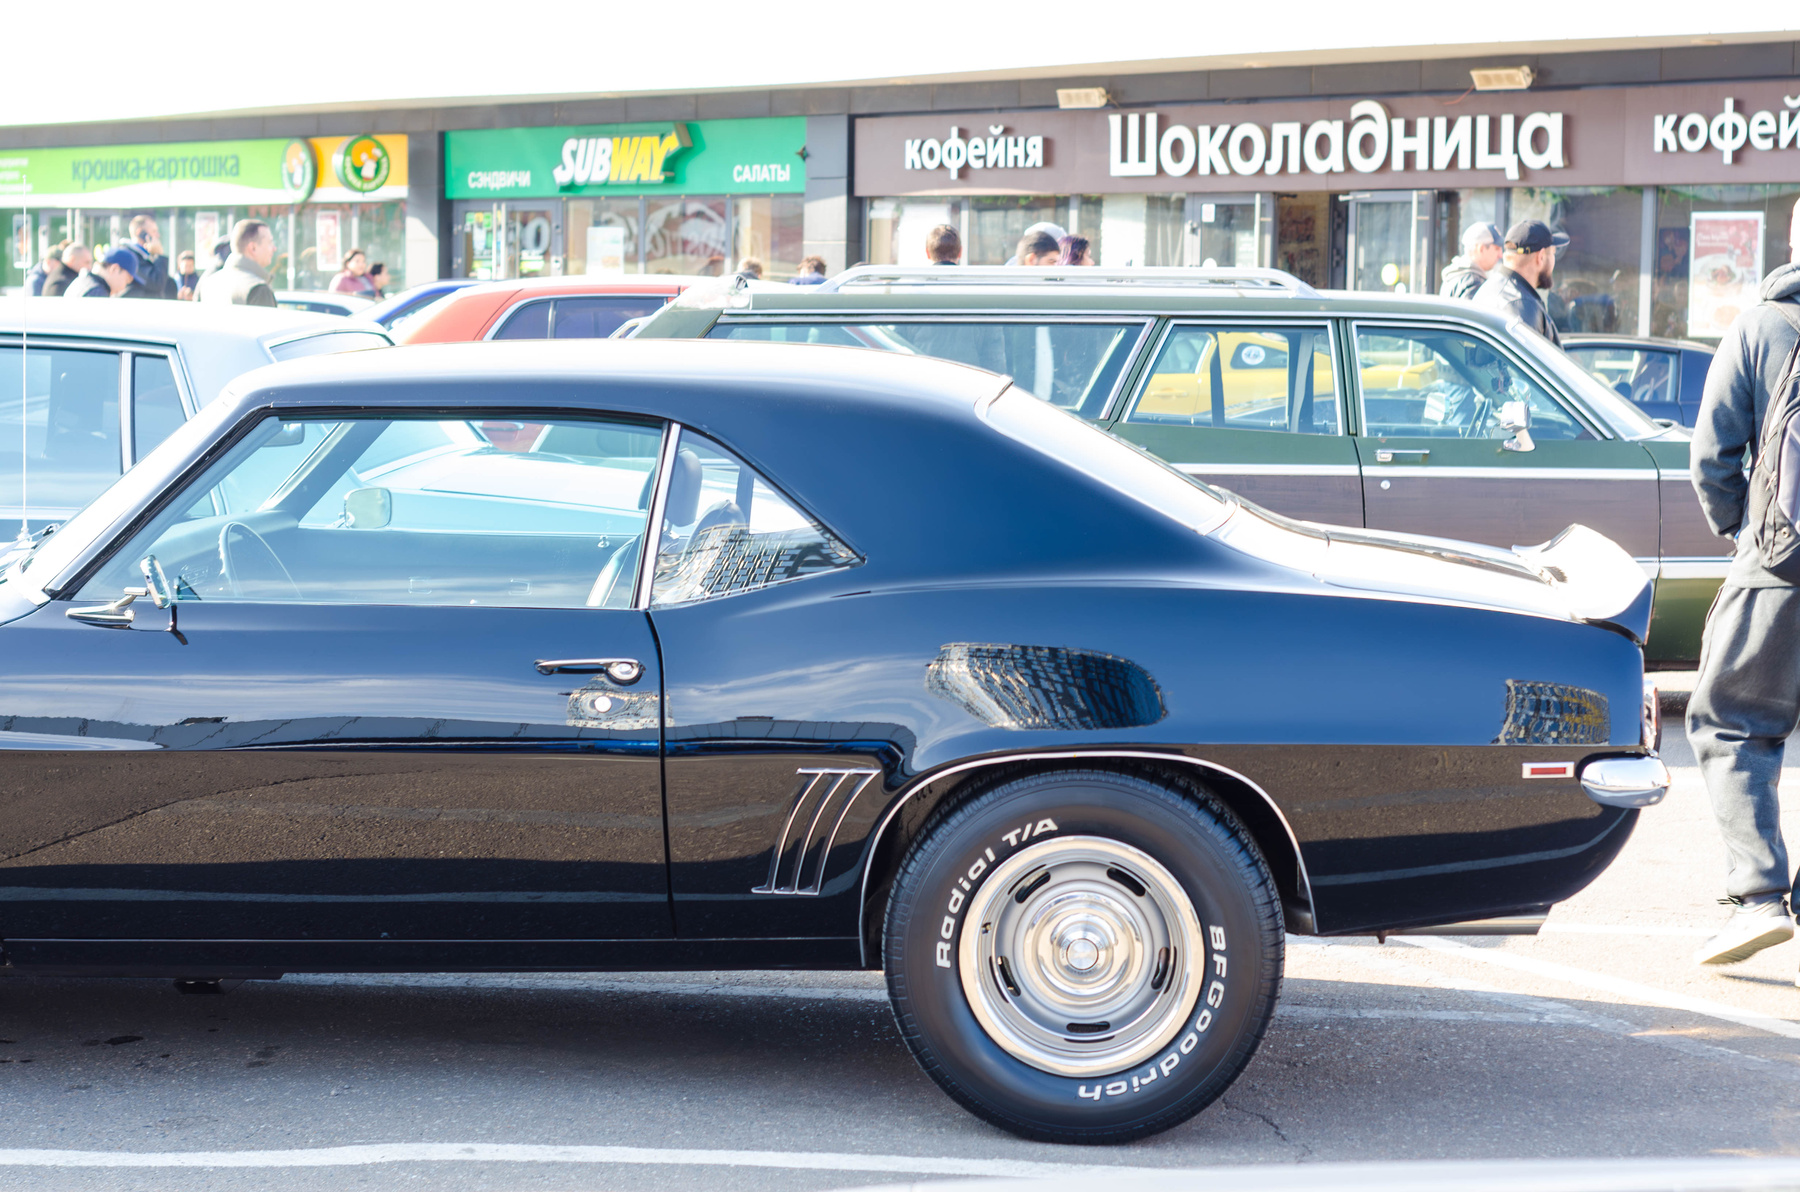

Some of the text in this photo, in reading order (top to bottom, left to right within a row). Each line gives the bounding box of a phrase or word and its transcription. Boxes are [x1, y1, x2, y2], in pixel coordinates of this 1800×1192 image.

[552, 130, 680, 187] SUBWAY
[904, 125, 1043, 179] кофейня
[1109, 100, 1566, 180] Шоколадница
[71, 154, 240, 188] крошка-картошка
[468, 170, 531, 190] СЭНДВИЧИ
[733, 164, 791, 182] САЛАТЫ
[936, 817, 1059, 969] Radial T/A
[1078, 925, 1227, 1102] BFGoodrich
